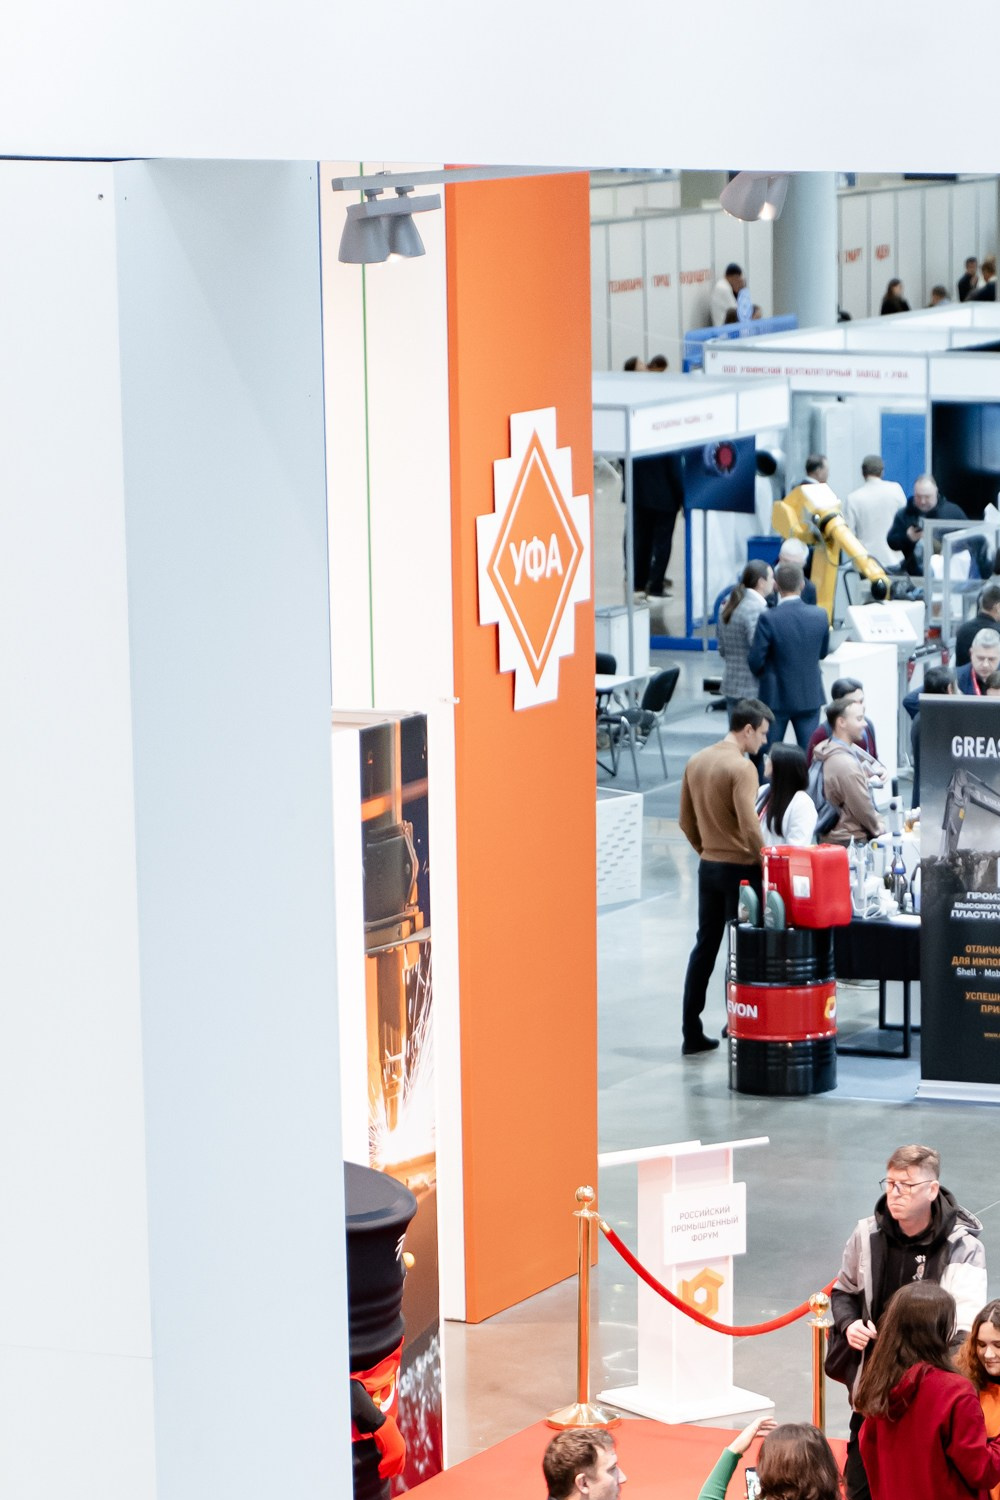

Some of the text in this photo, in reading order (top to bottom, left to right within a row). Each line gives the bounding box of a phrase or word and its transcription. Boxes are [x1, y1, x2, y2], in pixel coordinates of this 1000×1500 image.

[508, 532, 564, 587] УФА
[951, 956, 971, 966] ДЛЯ
[956, 967, 977, 977] Shell
[679, 1204, 731, 1221] РОССИЙСКИЙ
[671, 1215, 739, 1233] ПРОМЫШЛЕННЫЙ
[691, 1231, 719, 1242] ФОРУМ
